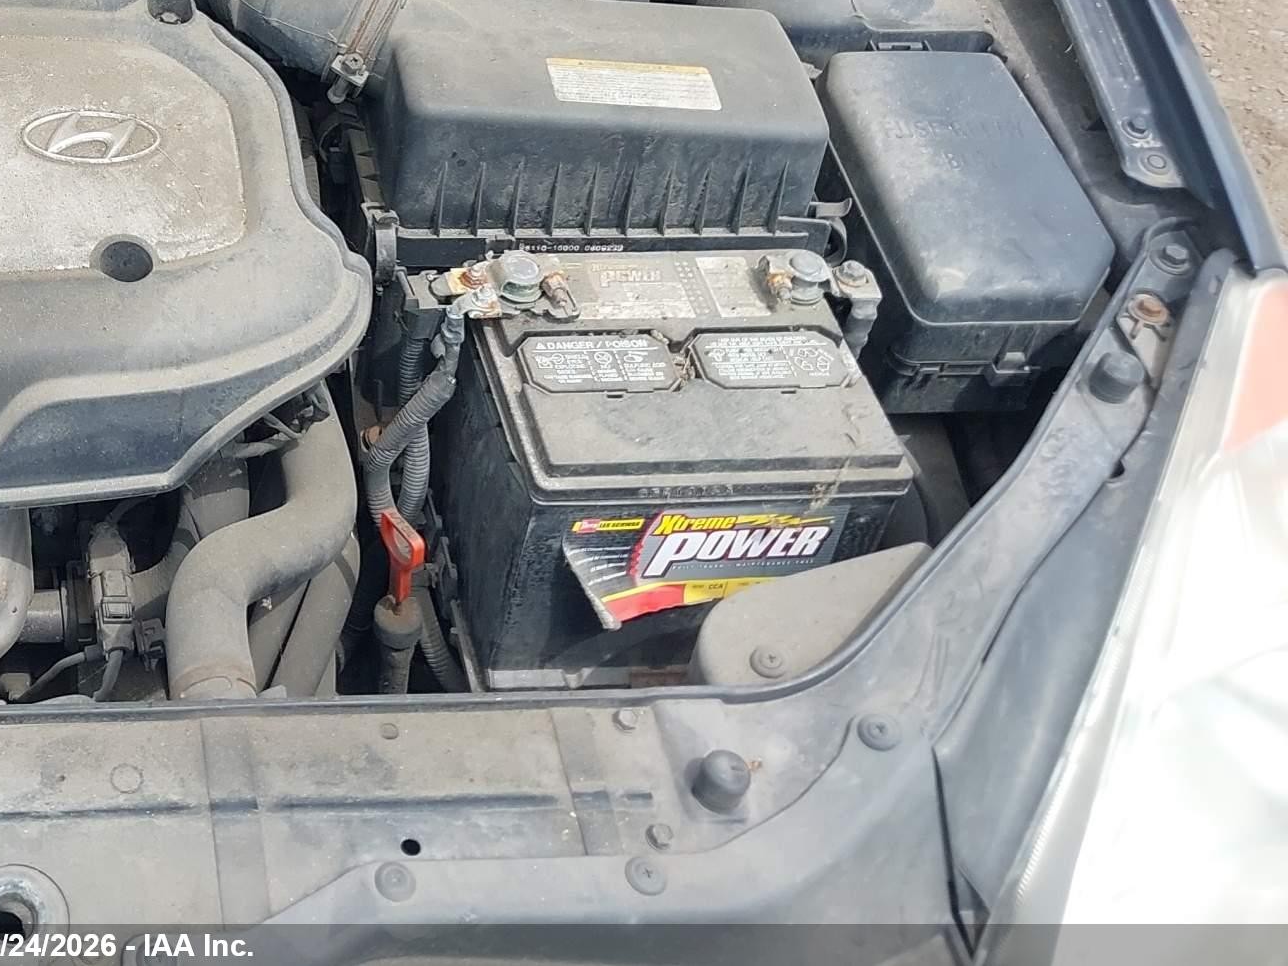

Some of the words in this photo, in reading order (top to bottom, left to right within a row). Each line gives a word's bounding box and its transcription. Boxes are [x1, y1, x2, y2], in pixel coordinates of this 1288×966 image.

[546, 341, 594, 350] DANGER
[605, 339, 648, 348] POISON
[653, 514, 738, 535] Xtreme
[642, 525, 831, 579] POWER
